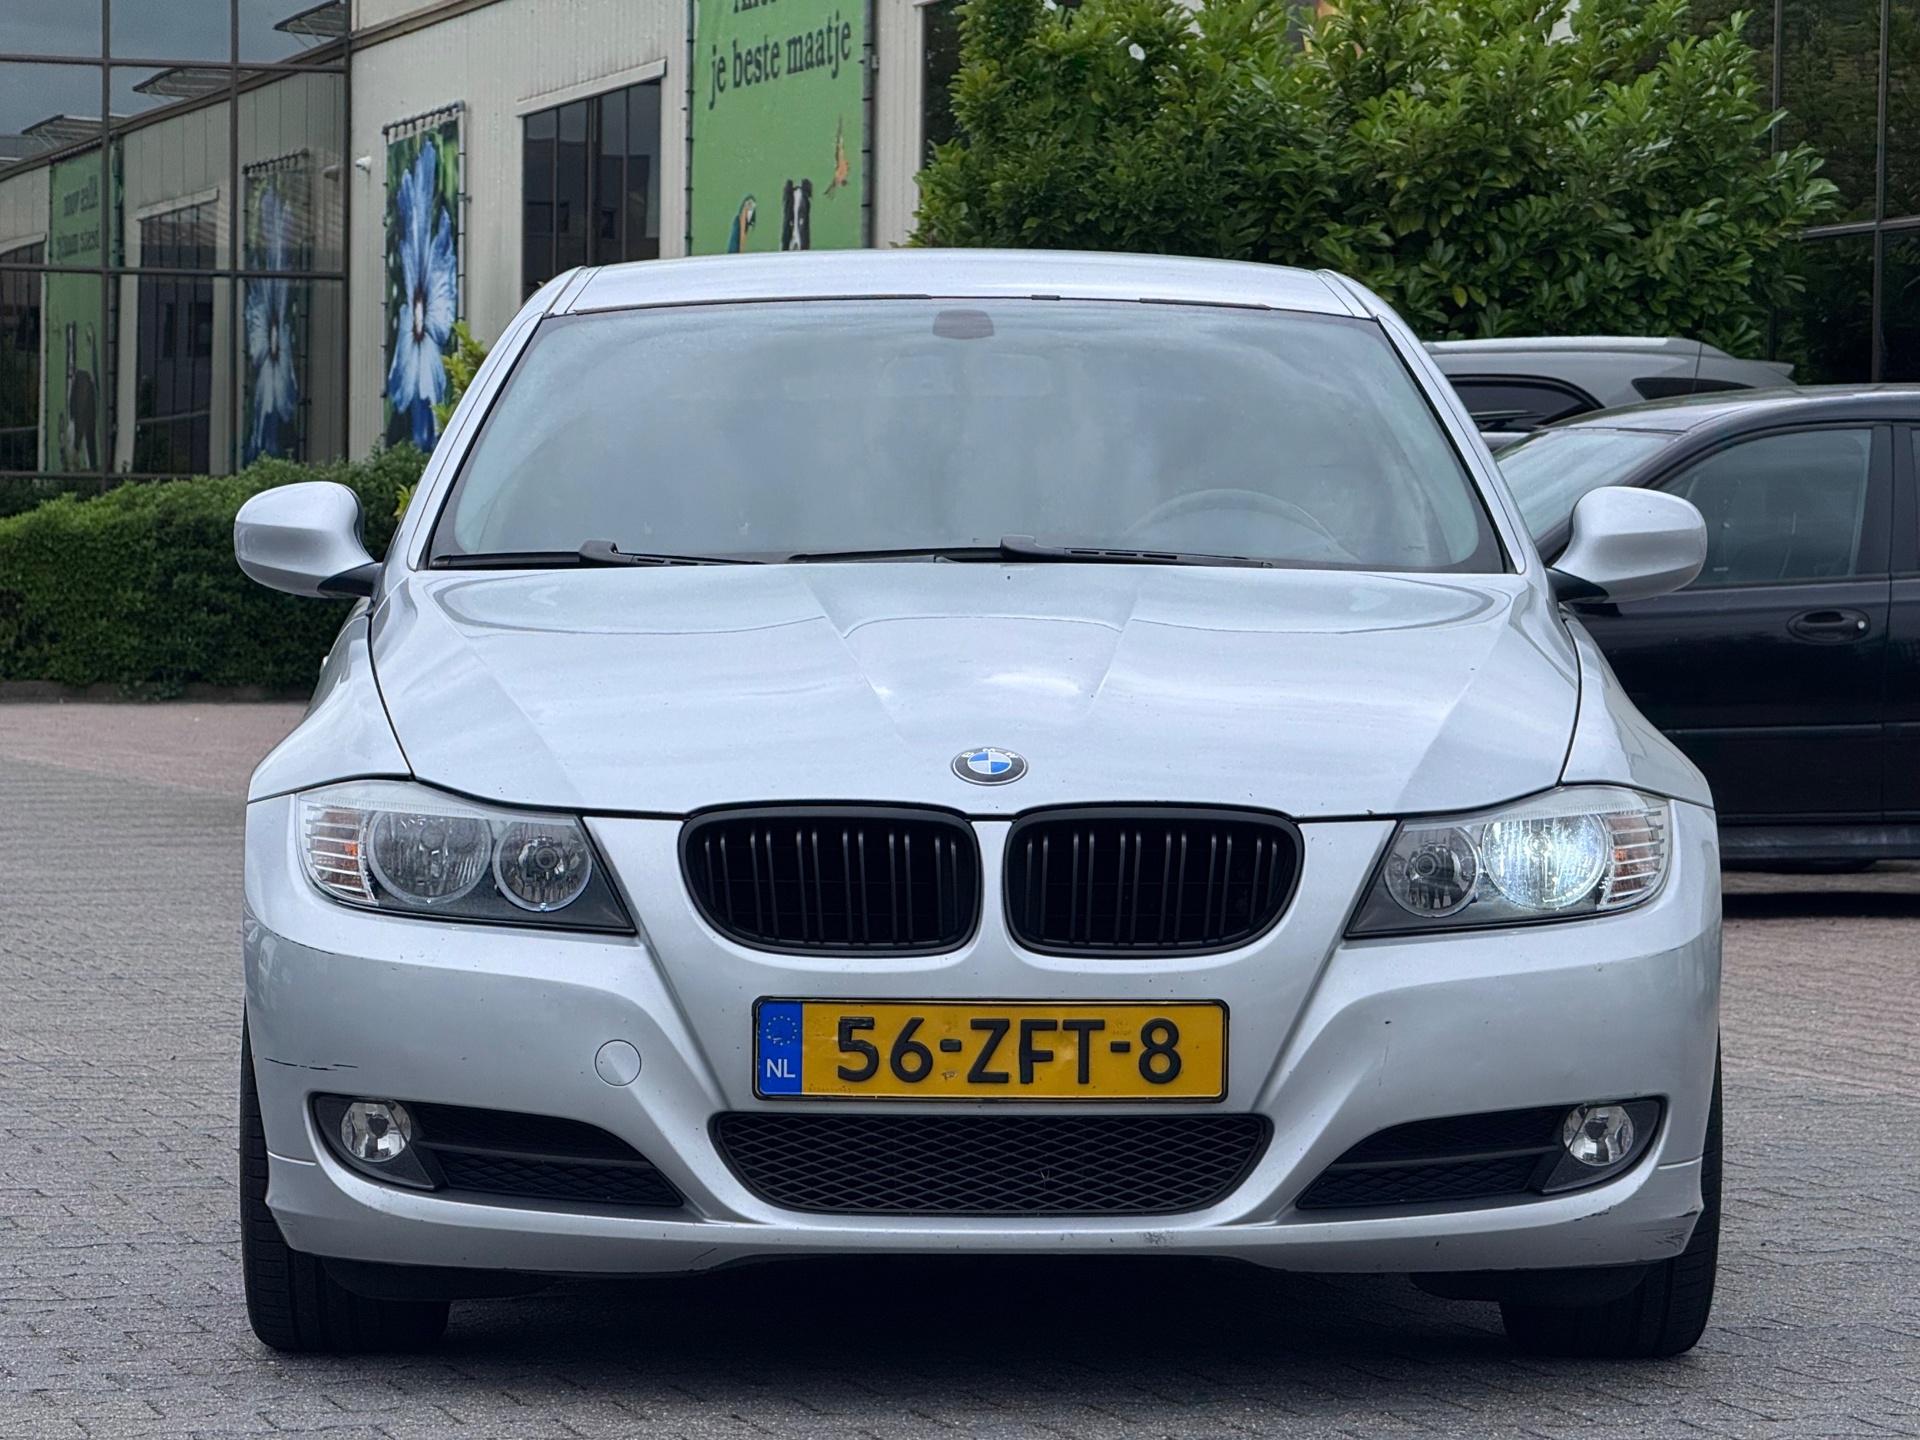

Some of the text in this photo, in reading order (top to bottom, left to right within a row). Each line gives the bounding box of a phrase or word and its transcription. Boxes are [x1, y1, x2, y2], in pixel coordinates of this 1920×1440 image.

[709, 9, 852, 110] je beste maatje
[766, 1058, 797, 1079] NL
[837, 1016, 1182, 1084] 56-ZFT-8
